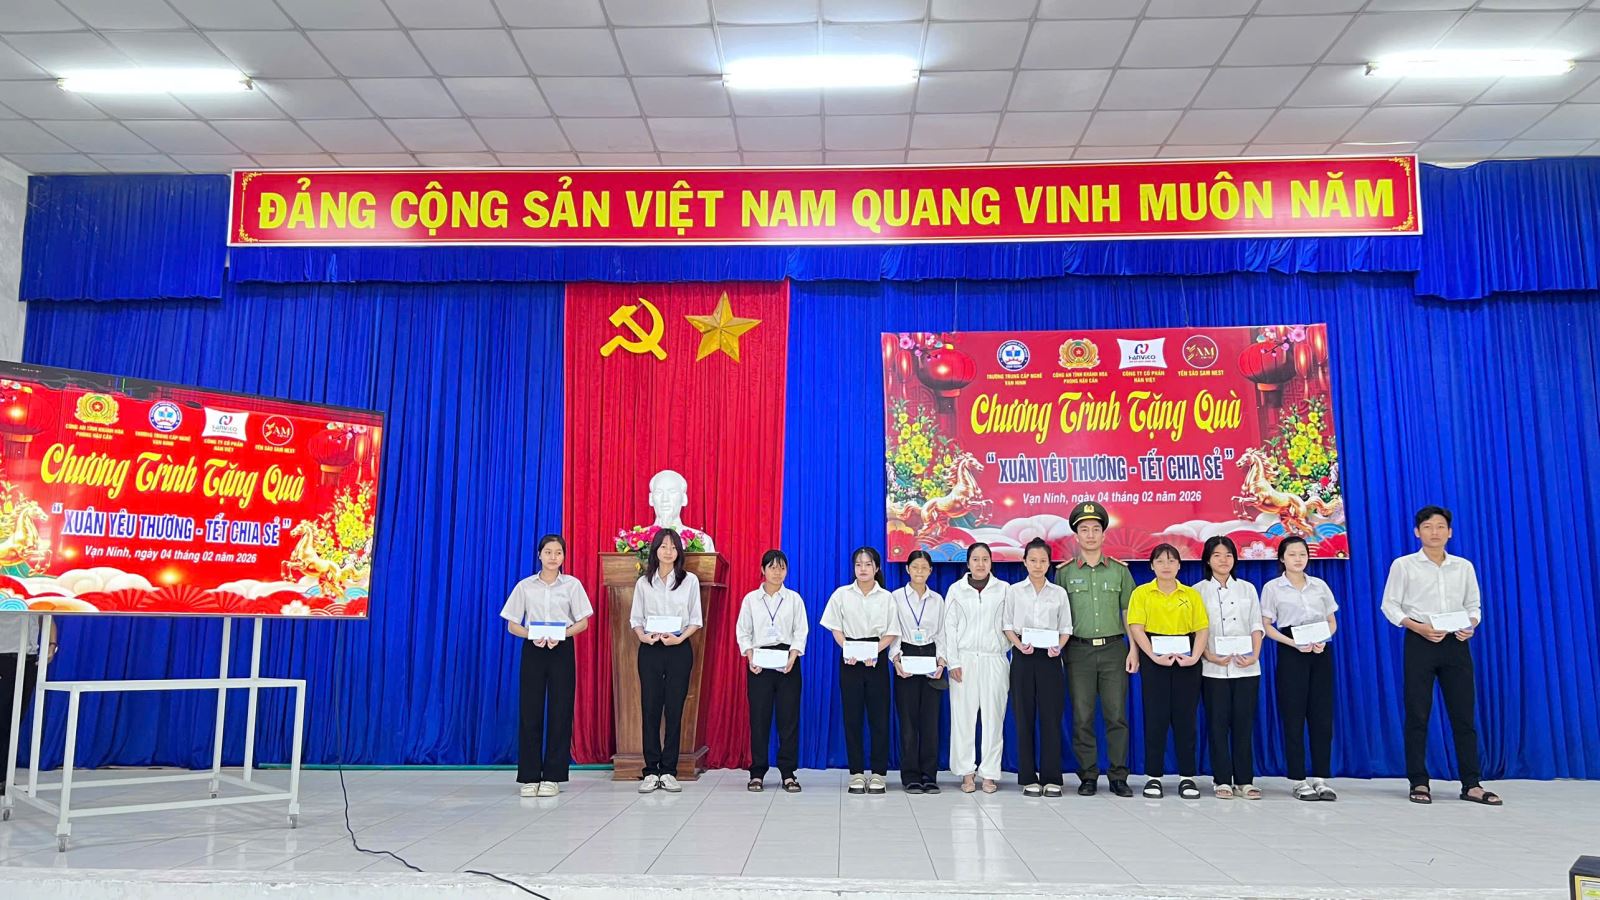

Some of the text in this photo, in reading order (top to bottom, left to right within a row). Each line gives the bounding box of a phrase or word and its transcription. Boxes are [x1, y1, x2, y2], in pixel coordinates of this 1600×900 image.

[258, 171, 1395, 236] ĐẢNG CỘNG SẢN VIỆT NAM QUANG VINH MUÔN NĂM
[970, 389, 1242, 444] Chương Trình Tặng Quà
[41, 443, 305, 509] Chương Trình Tặng Quà
[1039, 452, 1068, 482] YÊU
[1070, 454, 1127, 482] THƯƠNG
[1138, 448, 1164, 481] TẾT
[1167, 455, 1202, 480] CHIA
[1023, 491, 1201, 505] Vạn Ninh, ngày 04 tháng 02 năm 2026
[109, 508, 137, 538] YÊU
[139, 513, 194, 541] THƯƠNG
[205, 512, 229, 543] TẾT
[230, 520, 260, 545] CHIA
[85, 545, 257, 563] Vạn Ninh, ngày 04 tháng 02 năm 2026
